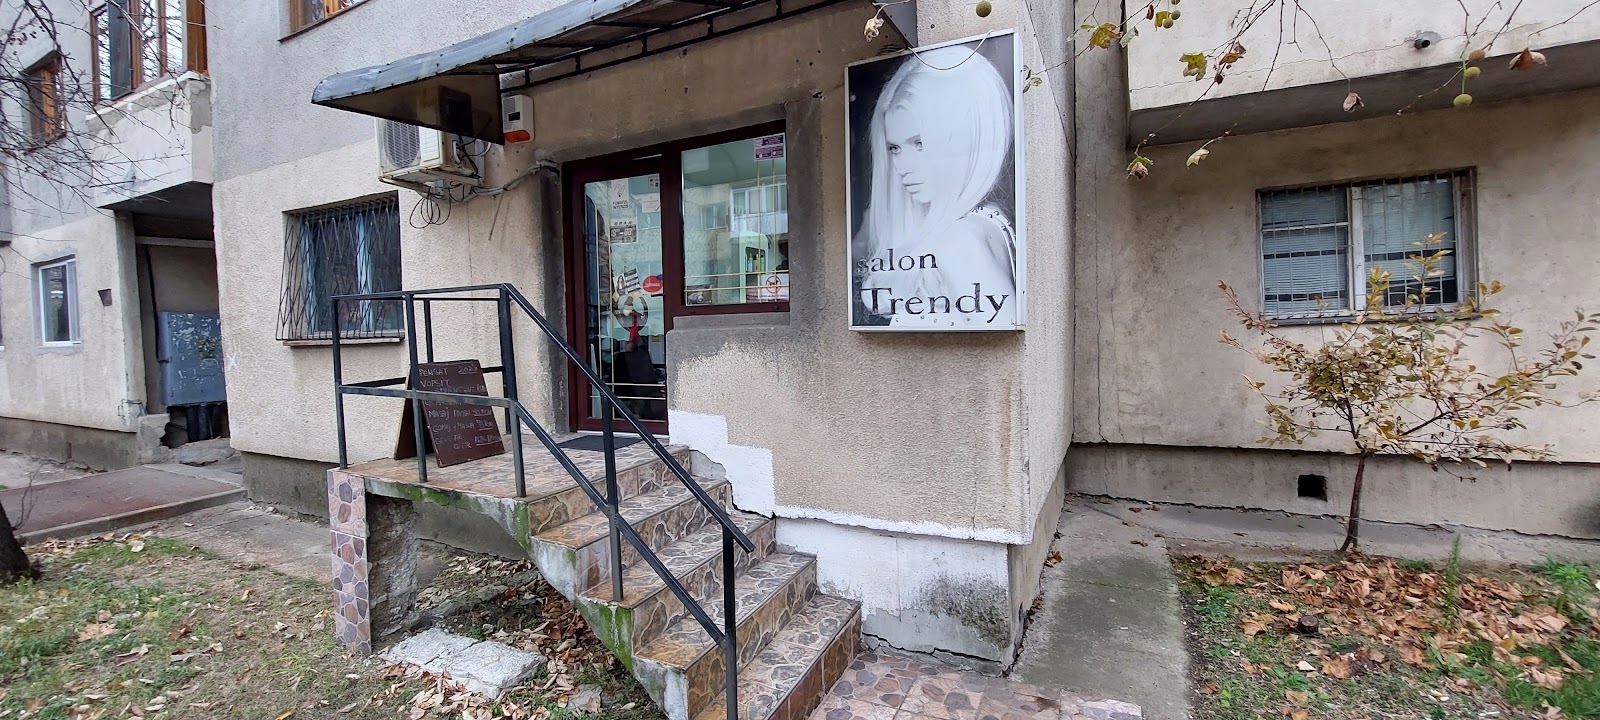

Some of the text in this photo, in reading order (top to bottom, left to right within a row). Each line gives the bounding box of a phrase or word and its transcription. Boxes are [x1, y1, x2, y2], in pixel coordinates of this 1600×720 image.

[856, 248, 939, 274] salon
[860, 282, 1010, 324] Trendy
[420, 379, 450, 388] VOPSIT
